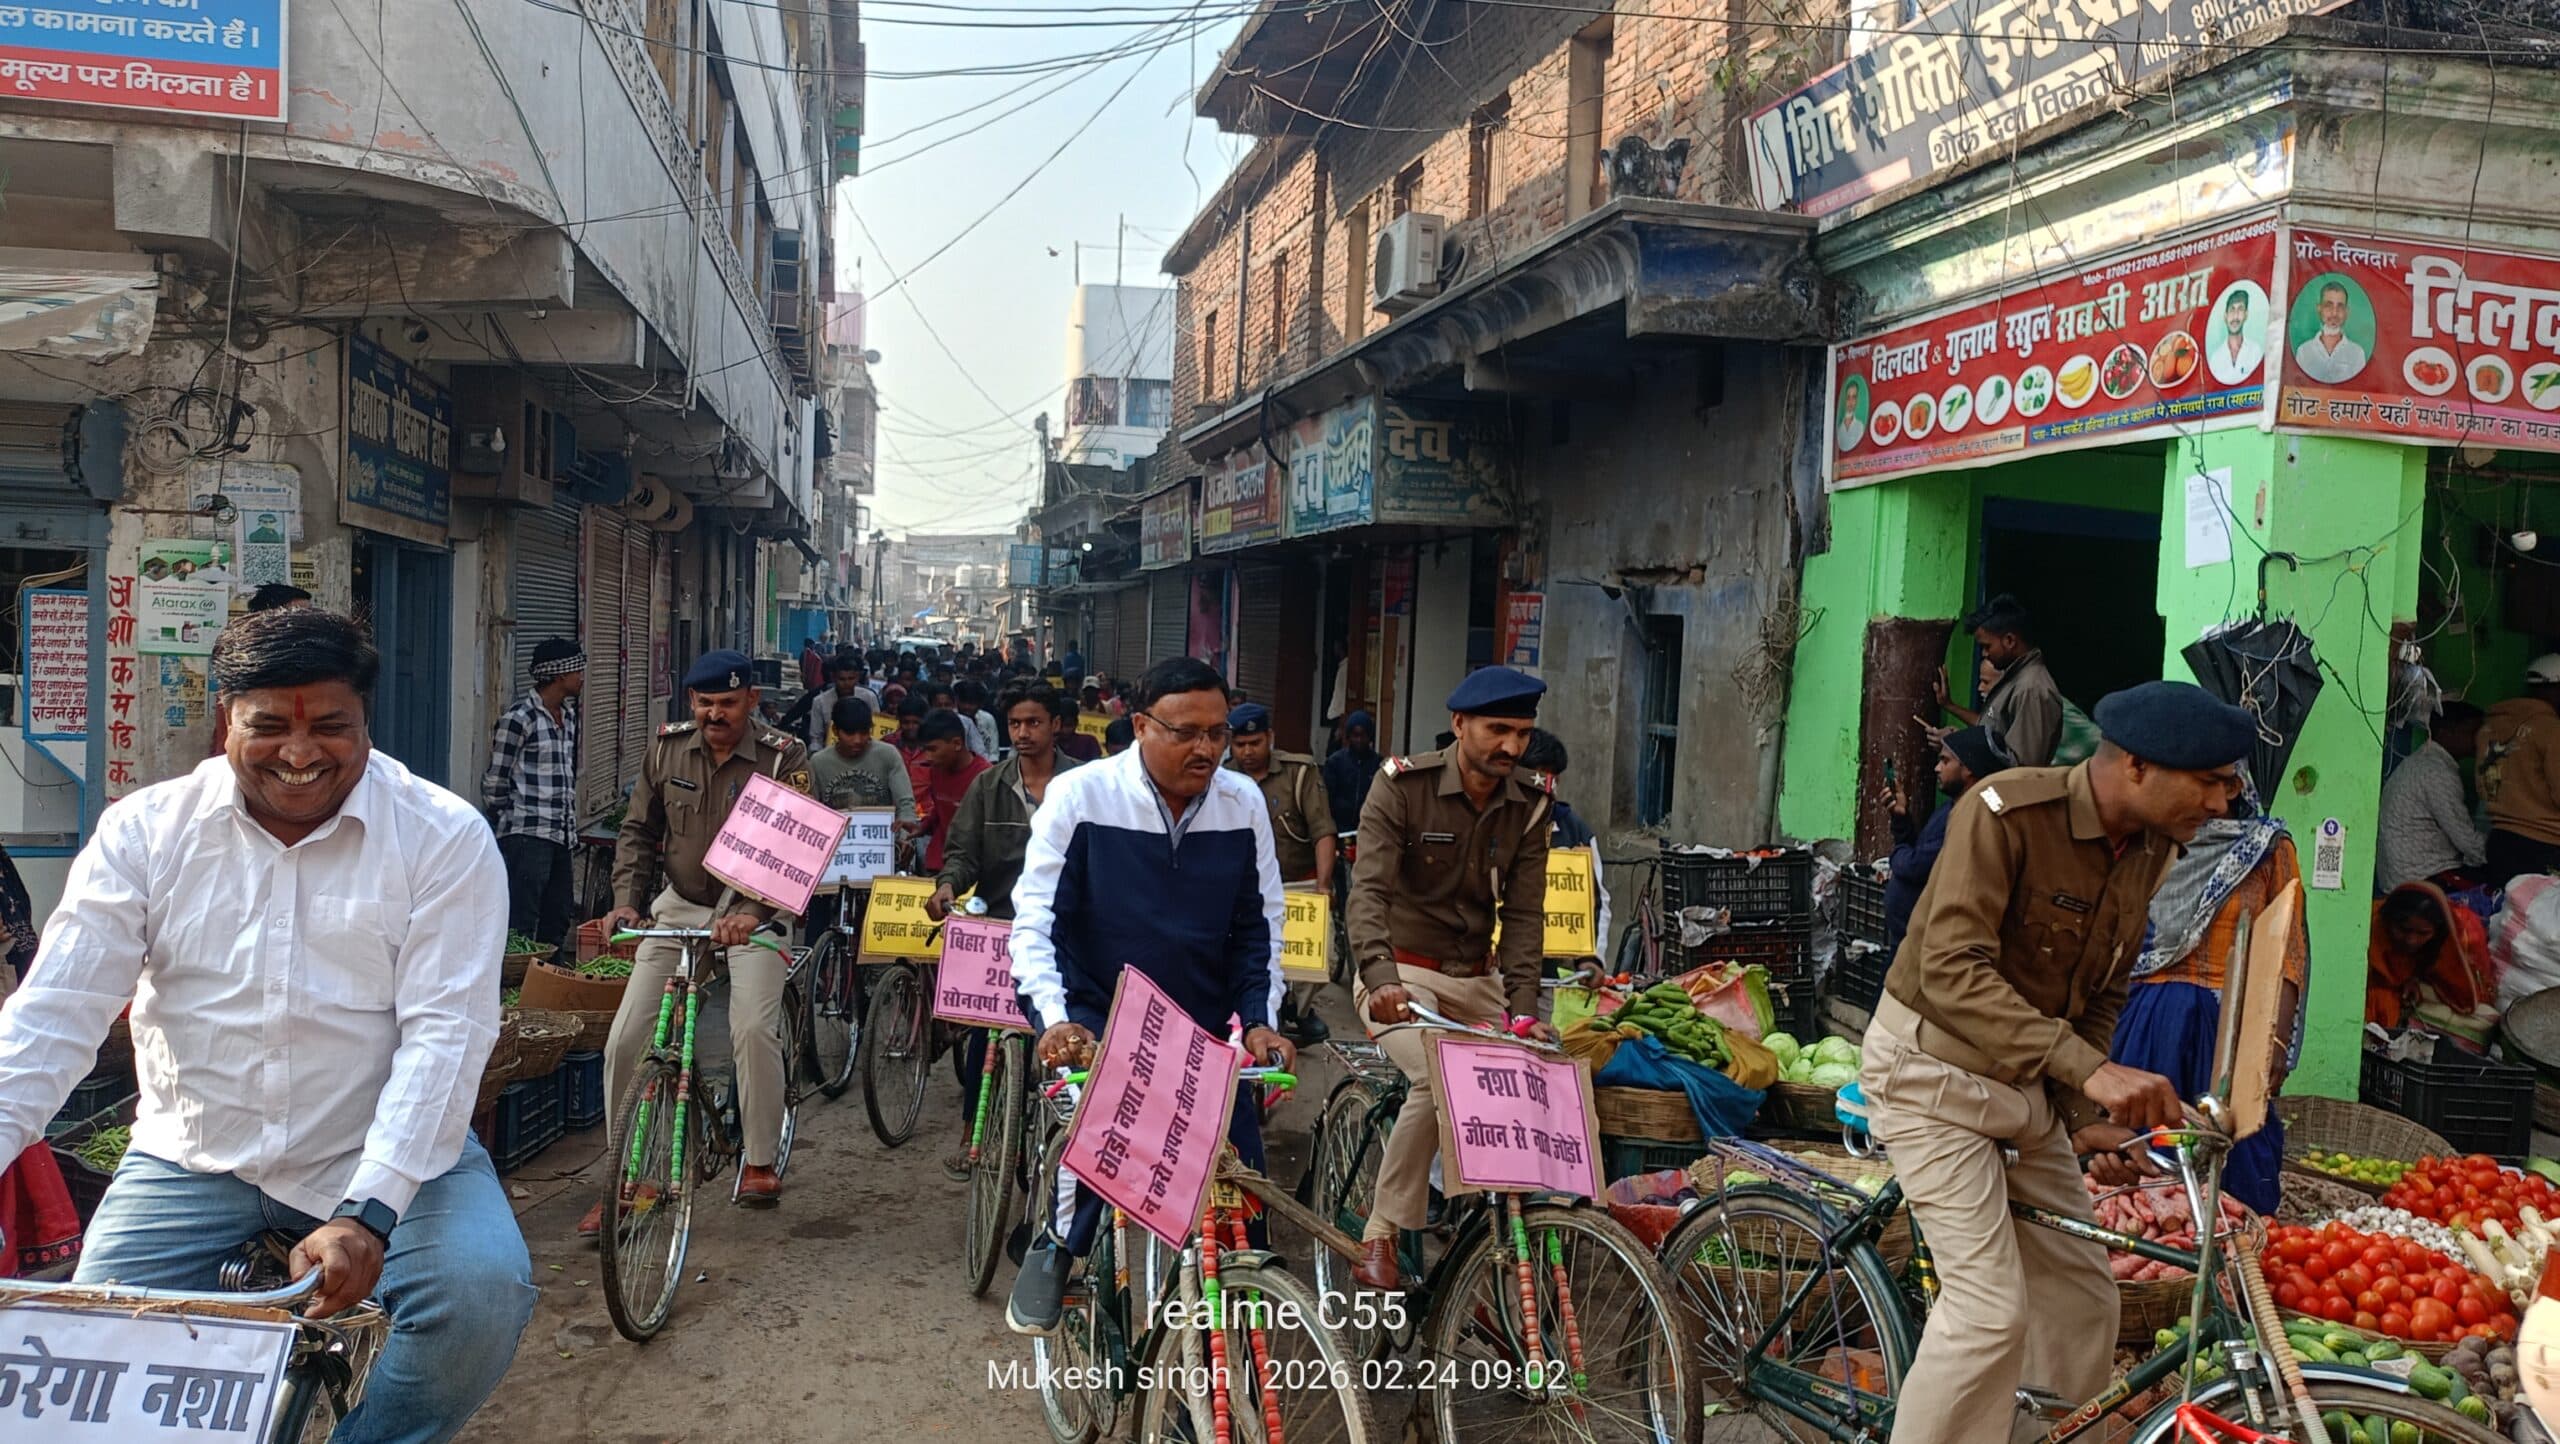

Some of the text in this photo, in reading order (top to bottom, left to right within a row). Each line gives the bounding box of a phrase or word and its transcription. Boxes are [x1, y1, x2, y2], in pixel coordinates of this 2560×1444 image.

[32, 8, 137, 37] कामना
[142, 16, 216, 45] करते
[0, 57, 71, 91] मूल्य
[76, 64, 121, 90] पर
[123, 62, 223, 97] मिलता
[1786, 90, 1857, 177] शिव
[1933, 125, 1980, 164] थोक
[1987, 108, 2029, 141] दवा
[1871, 340, 1931, 384] दिलदार
[1931, 345, 1943, 365] &
[1945, 320, 1999, 376] गुलाम
[352, 368, 389, 443] अशोक
[393, 384, 429, 462] मेडिकल
[2207, 396, 2225, 411] राज
[2378, 398, 2411, 425] यहाँ
[2416, 404, 2450, 428] सभी
[2455, 412, 2497, 433] प्रकार
[2501, 417, 2522, 437] का
[1384, 405, 1455, 463] देव
[1289, 430, 1326, 517] देव
[152, 596, 197, 609] Atarax
[771, 809, 798, 837] और
[797, 822, 831, 852] शराब
[861, 824, 890, 840] नशा
[755, 848, 784, 874] जीवन
[784, 862, 815, 888] खराब
[834, 849, 886, 869] होगा दुर्दशा
[1545, 867, 1585, 892] मजोर
[875, 892, 894, 907] नशा
[895, 893, 917, 912] मुक्त
[1305, 901, 1317, 923] है
[873, 921, 908, 942] खुशहाल
[949, 926, 988, 954] बिहार
[943, 986, 1000, 1013] सोनवर्षा
[1096, 994, 1167, 1182] छोड़ो नशा और शराब
[1177, 1070, 1199, 1116] जीवन
[1473, 1065, 1521, 1098] नशा
[1162, 1112, 1190, 1166] अपना
[1462, 1116, 1509, 1149] जीवन
[1512, 1119, 1529, 1150] से
[1150, 1161, 1174, 1197] करो
[1140, 1194, 1161, 1216] न
[142, 1364, 264, 1432] नशा
